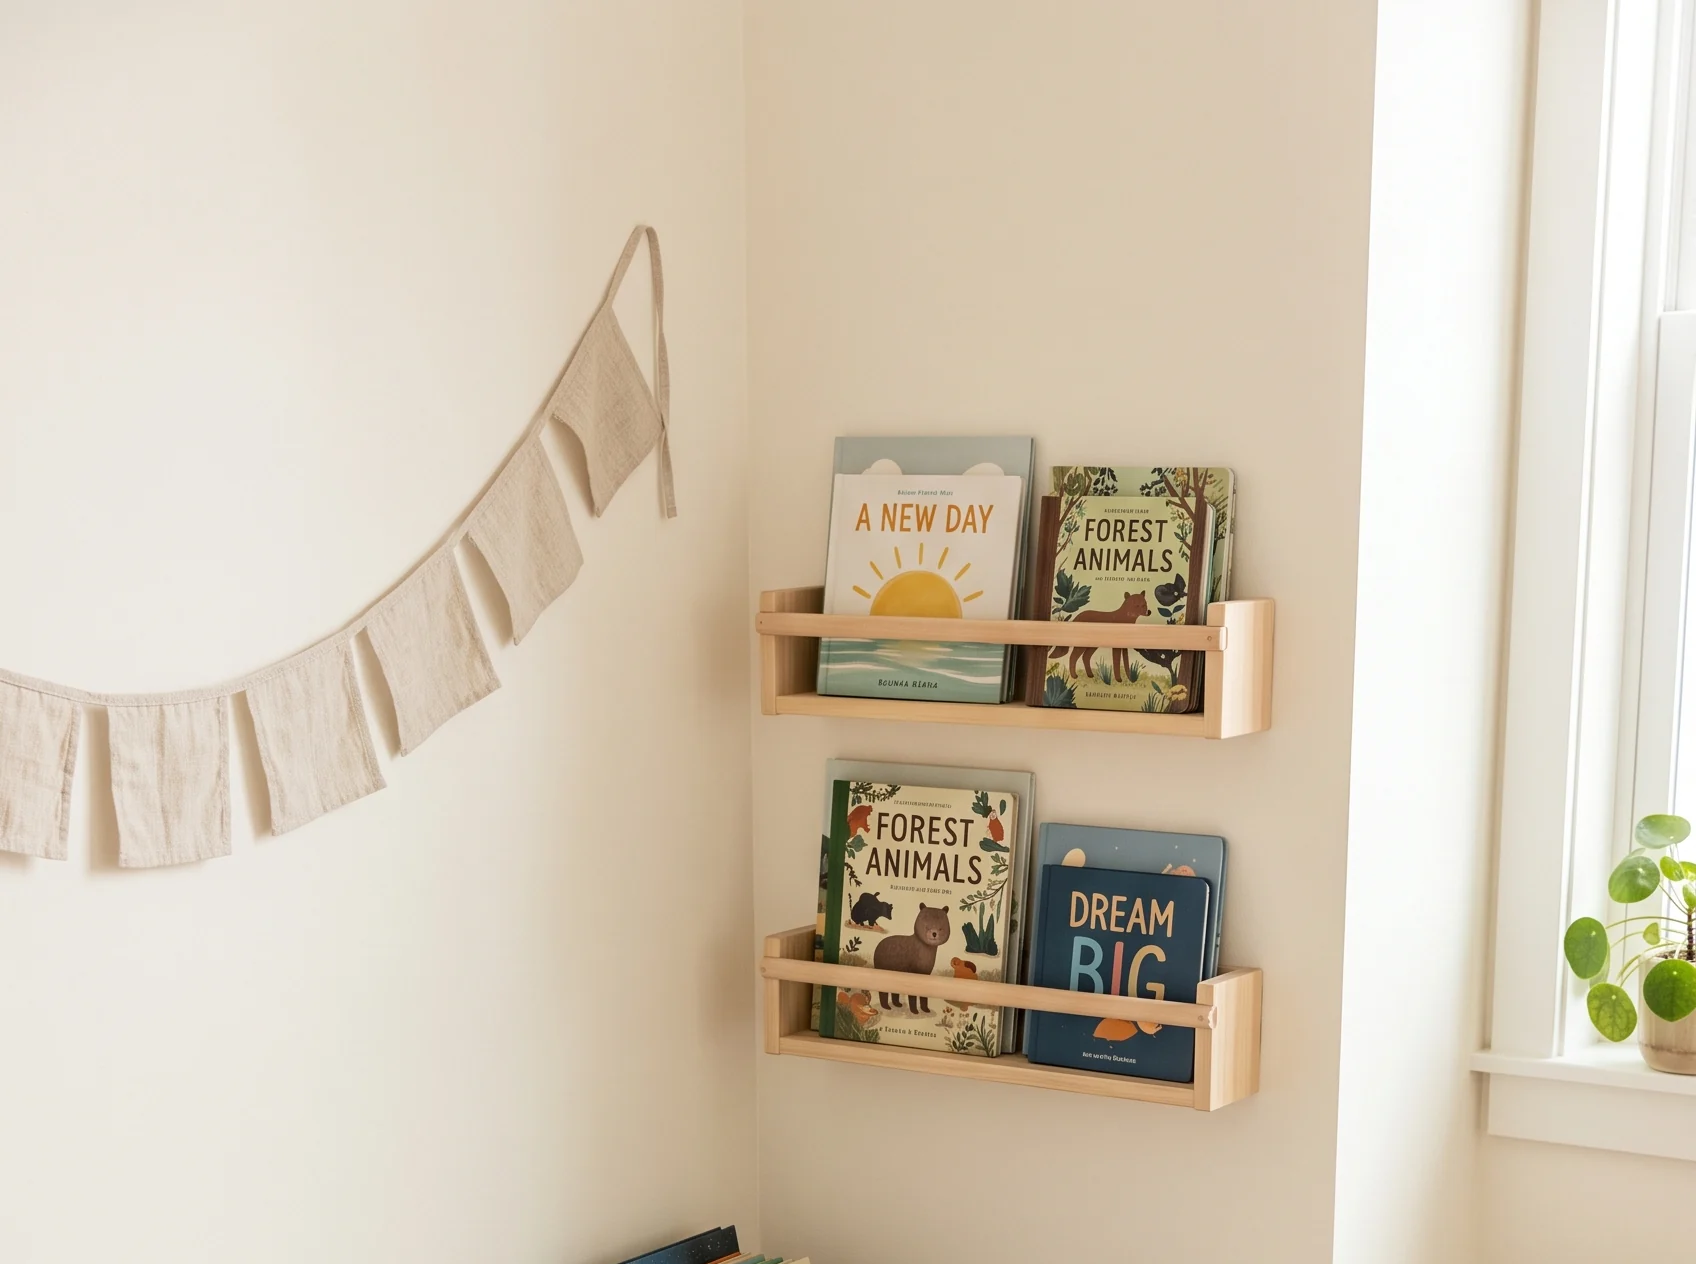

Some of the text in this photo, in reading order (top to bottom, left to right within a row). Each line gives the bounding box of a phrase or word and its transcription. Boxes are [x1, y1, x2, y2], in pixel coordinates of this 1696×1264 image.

[855, 503, 994, 534] A NEW DAY
[1084, 518, 1168, 543] FOREST
[1073, 547, 1173, 573] ANIMALS
[877, 812, 974, 848] FOREST
[865, 847, 982, 885] ANIMALS
[1069, 890, 1175, 938] DREAM
[1069, 935, 1166, 1001] BIG
